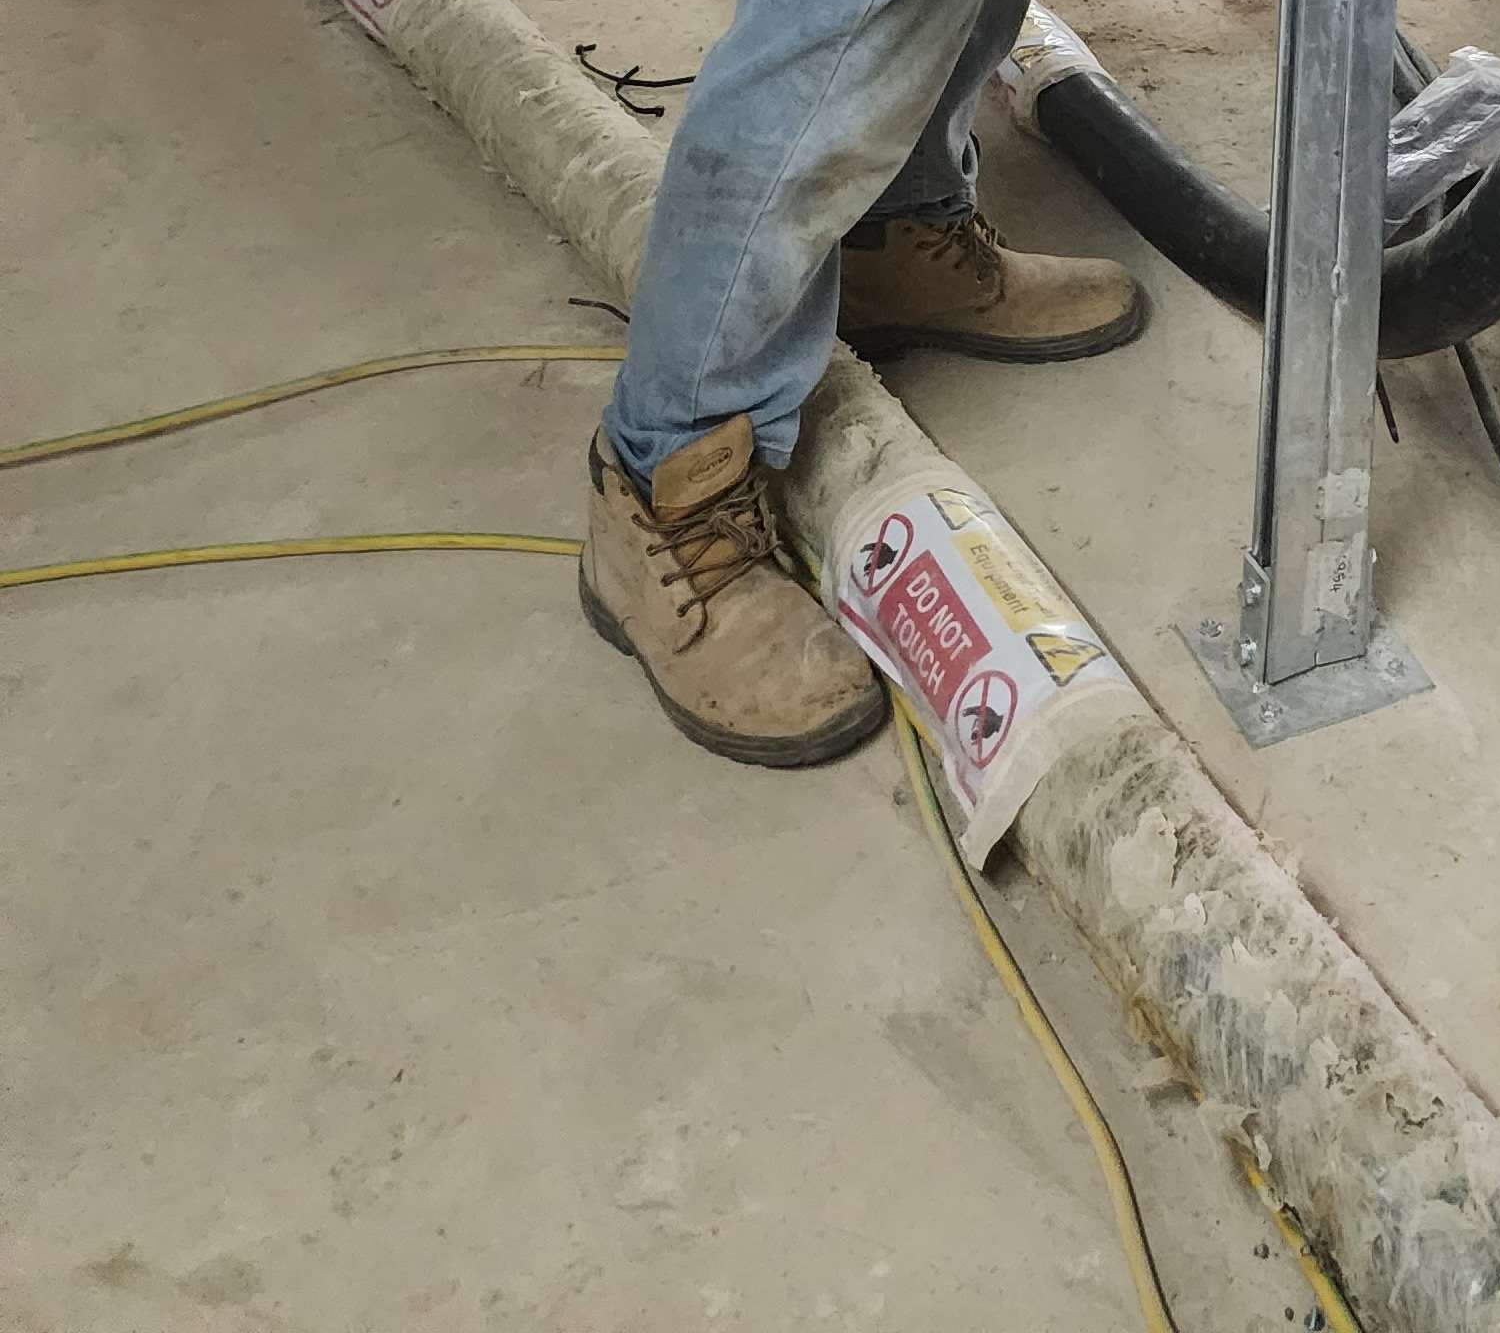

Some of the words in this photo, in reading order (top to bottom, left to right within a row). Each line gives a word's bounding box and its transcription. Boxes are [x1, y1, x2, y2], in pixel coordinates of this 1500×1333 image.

[907, 570, 939, 613] DO
[929, 608, 974, 661] NOT
[969, 543, 1031, 614] Equipment
[888, 602, 945, 697] TOUCH
